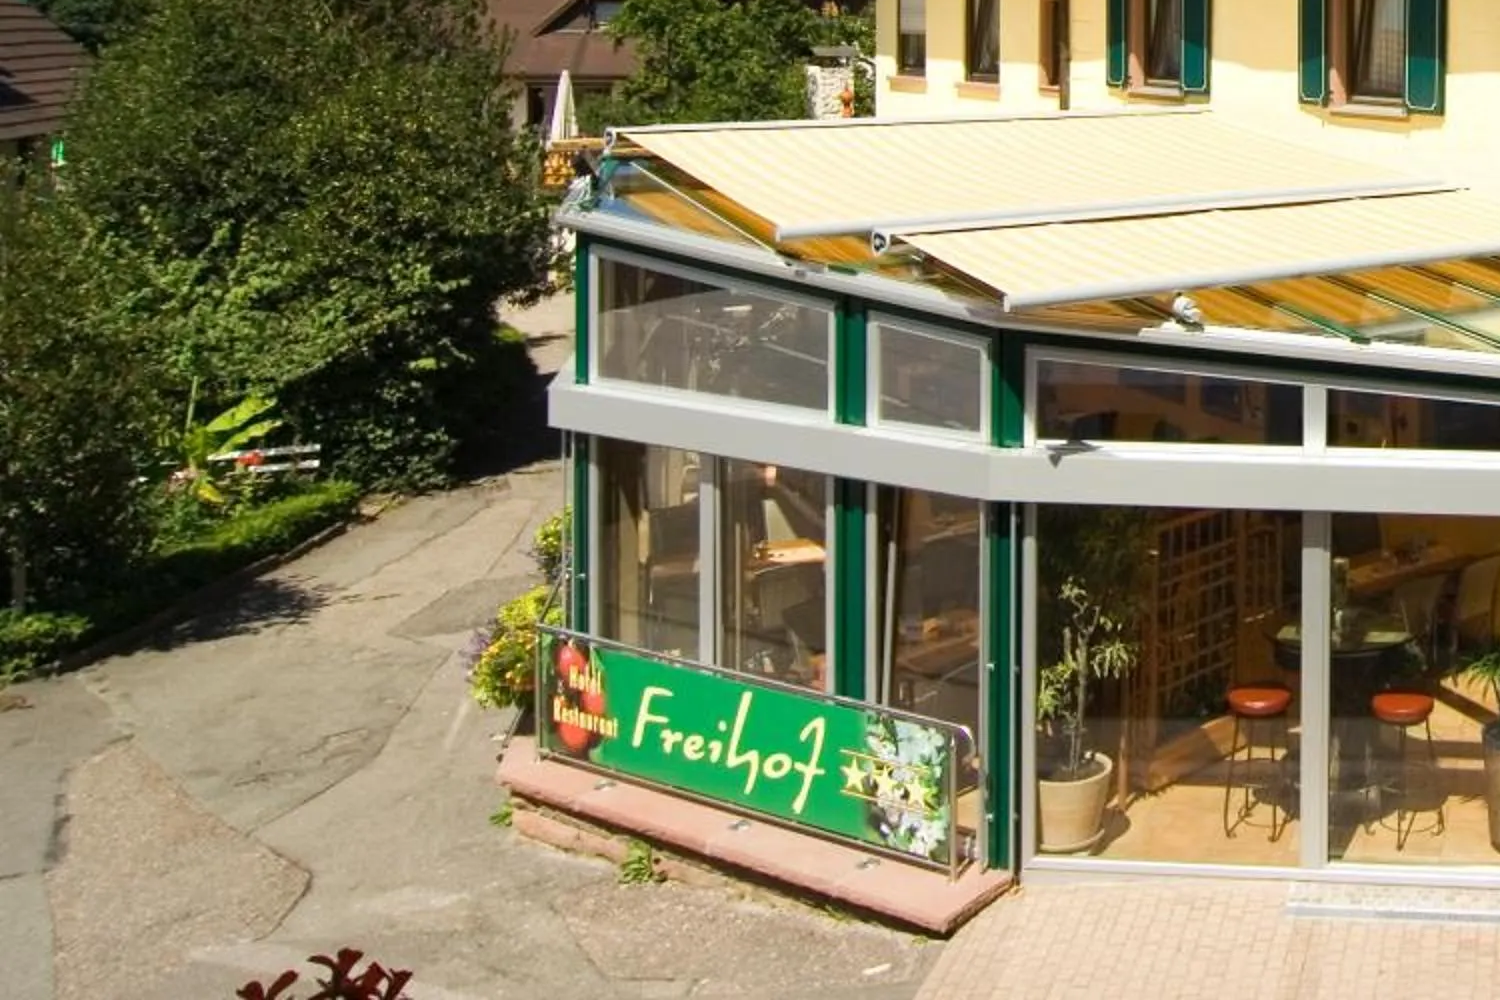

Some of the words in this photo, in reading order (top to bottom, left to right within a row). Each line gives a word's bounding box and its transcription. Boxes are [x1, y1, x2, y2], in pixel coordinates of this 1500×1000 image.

[568, 663, 602, 695] Hotel
[552, 694, 619, 738] Restaurant
[631, 685, 827, 815] Freihof
